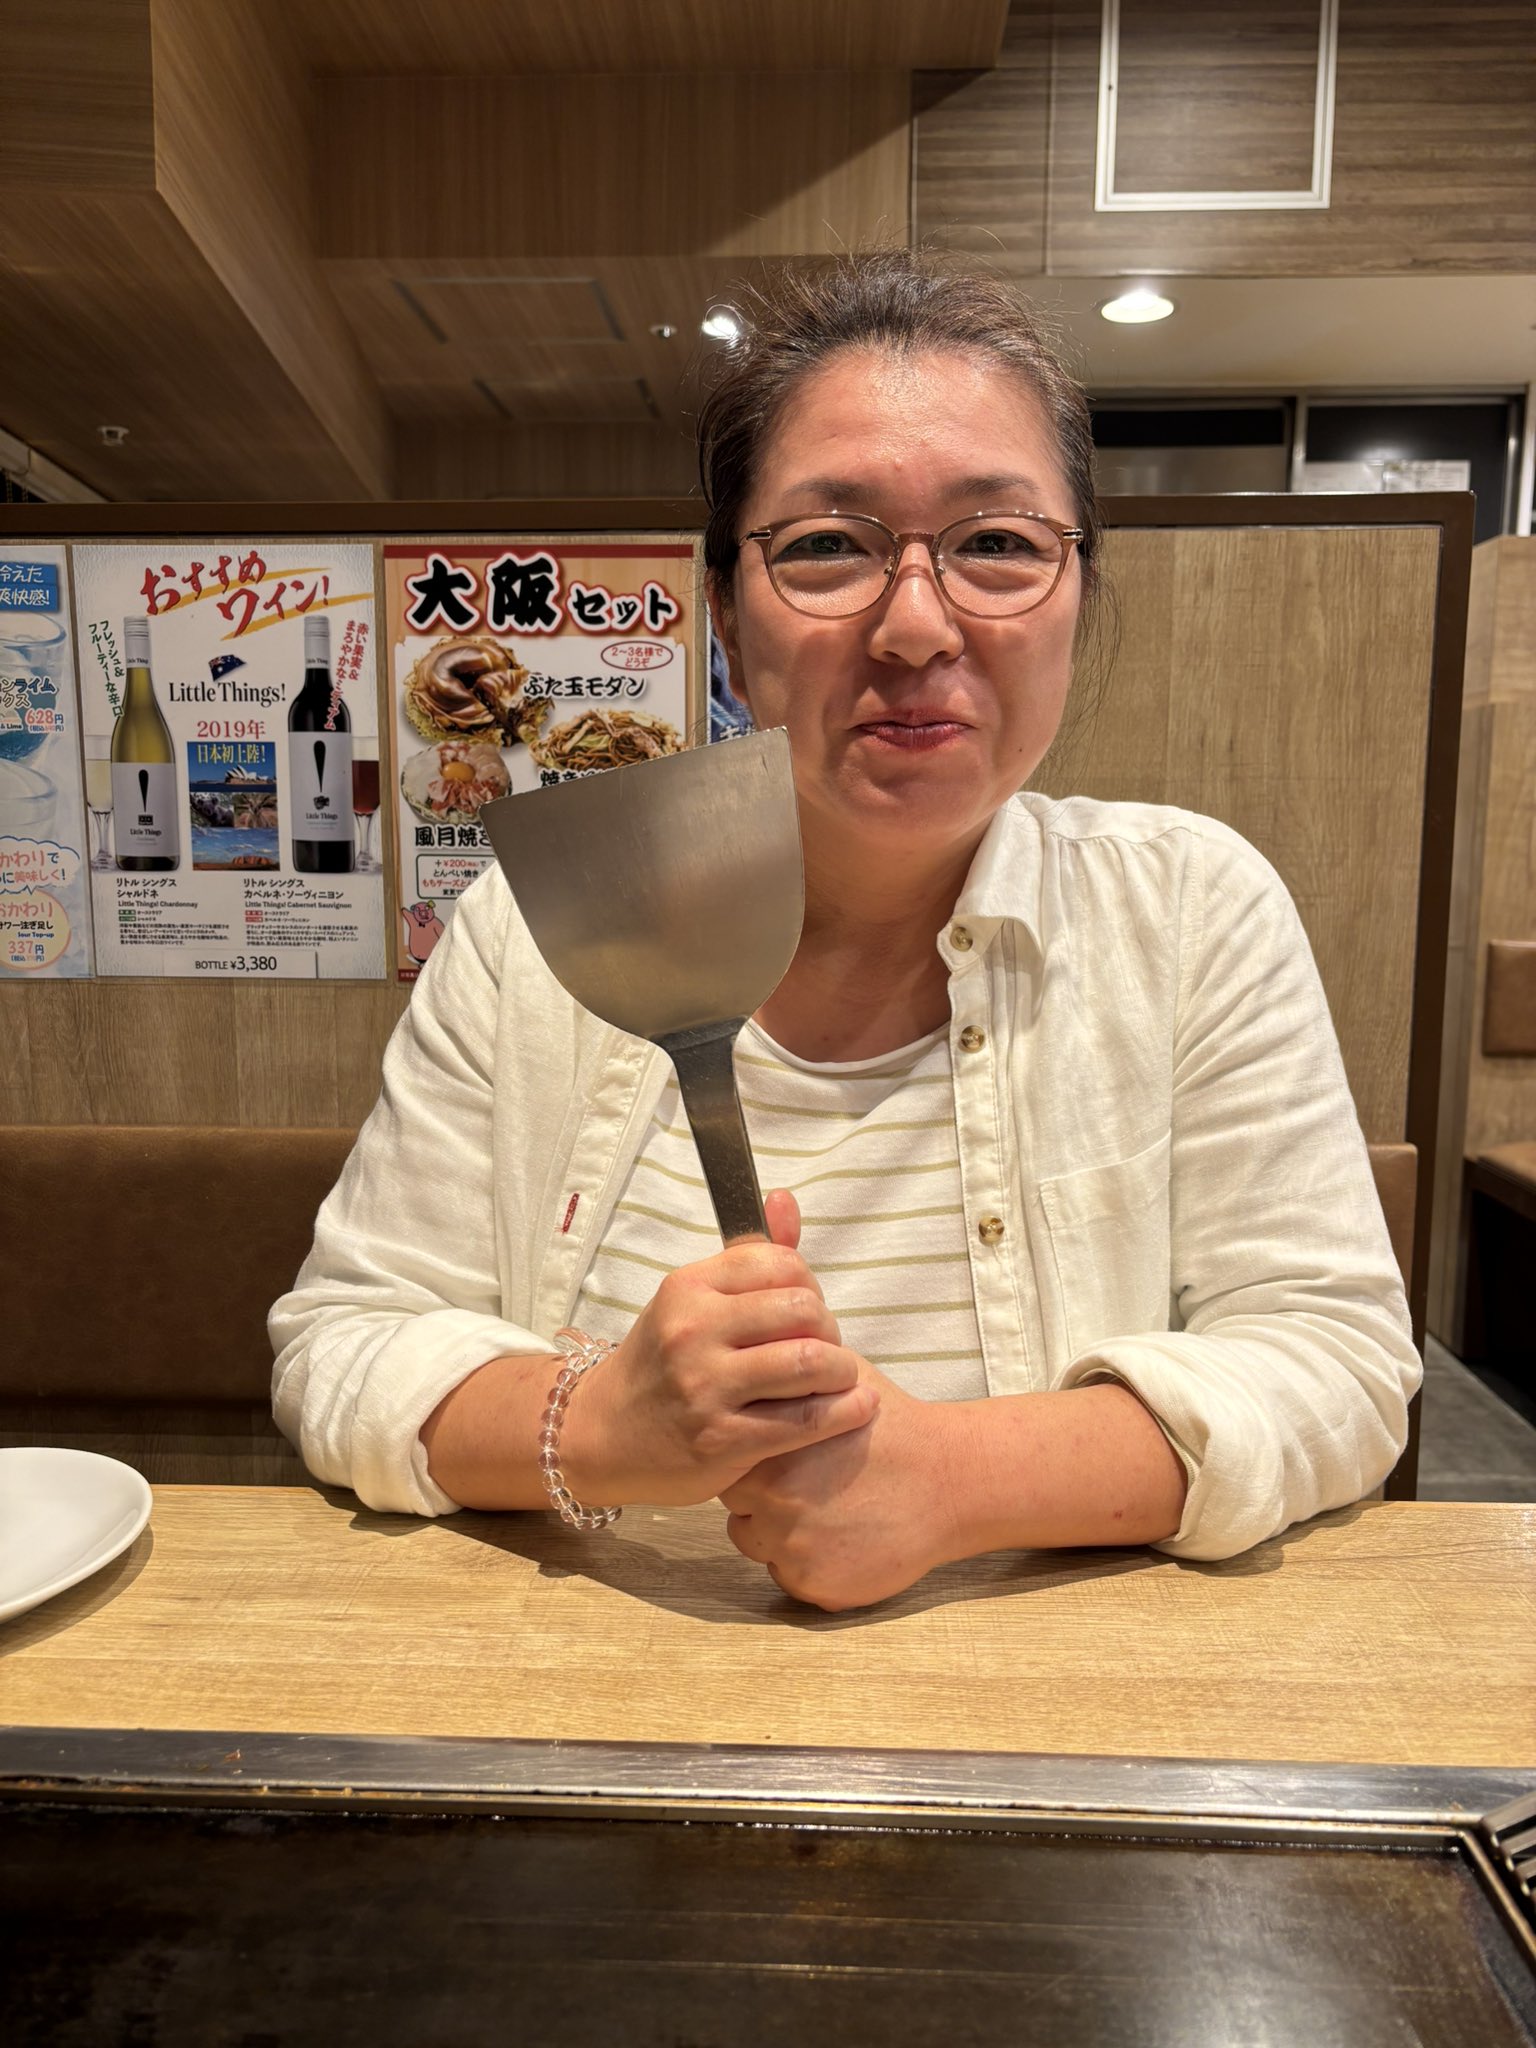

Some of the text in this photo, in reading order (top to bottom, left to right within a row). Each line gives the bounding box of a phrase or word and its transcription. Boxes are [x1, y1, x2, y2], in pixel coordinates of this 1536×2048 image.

[140, 551, 267, 616] おすすめ
[409, 556, 674, 628] 大阪セット
[625, 658, 650, 667] どうぞ
[0, 677, 56, 693] ンライム
[524, 676, 644, 696] ぶた玉モダン
[169, 681, 286, 708] Little Things!
[27, 709, 64, 725] 628円
[197, 720, 265, 740] 2019年
[197, 744, 266, 764] 日本初上陸!
[0, 868, 65, 884] に美味しく!
[117, 877, 177, 887] リトル シングス
[244, 878, 305, 888] リトル シングス
[117, 889, 158, 898] シャルドネ
[318, 902, 352, 910] Sauvignon
[8, 940, 44, 955] 337円
[195, 956, 277, 972] BOTTLE ¥3,380
